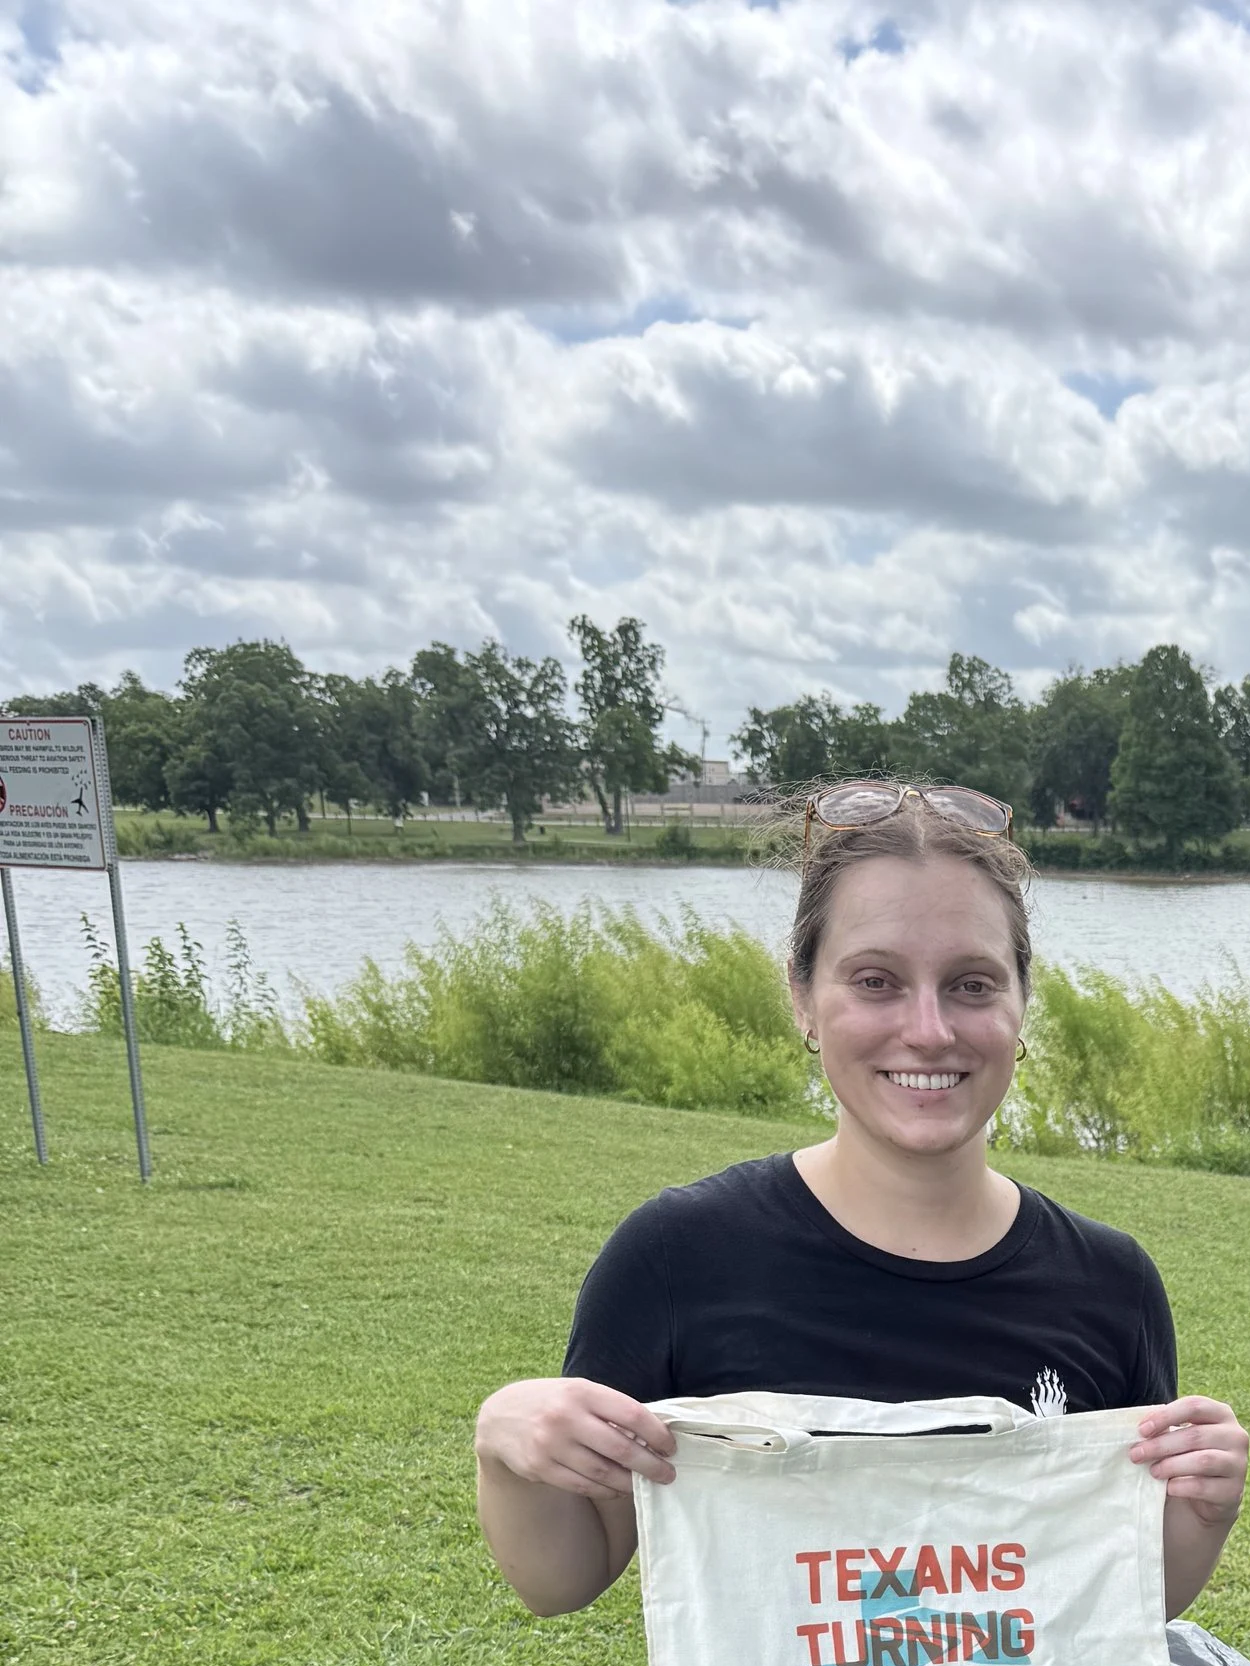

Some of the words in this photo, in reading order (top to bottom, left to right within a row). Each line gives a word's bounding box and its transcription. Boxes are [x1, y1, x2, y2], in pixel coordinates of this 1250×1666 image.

[8, 728, 50, 741] CAUTION
[9, 801, 69, 818] PRECAUCIÓN
[795, 1542, 1026, 1604] TEXANS
